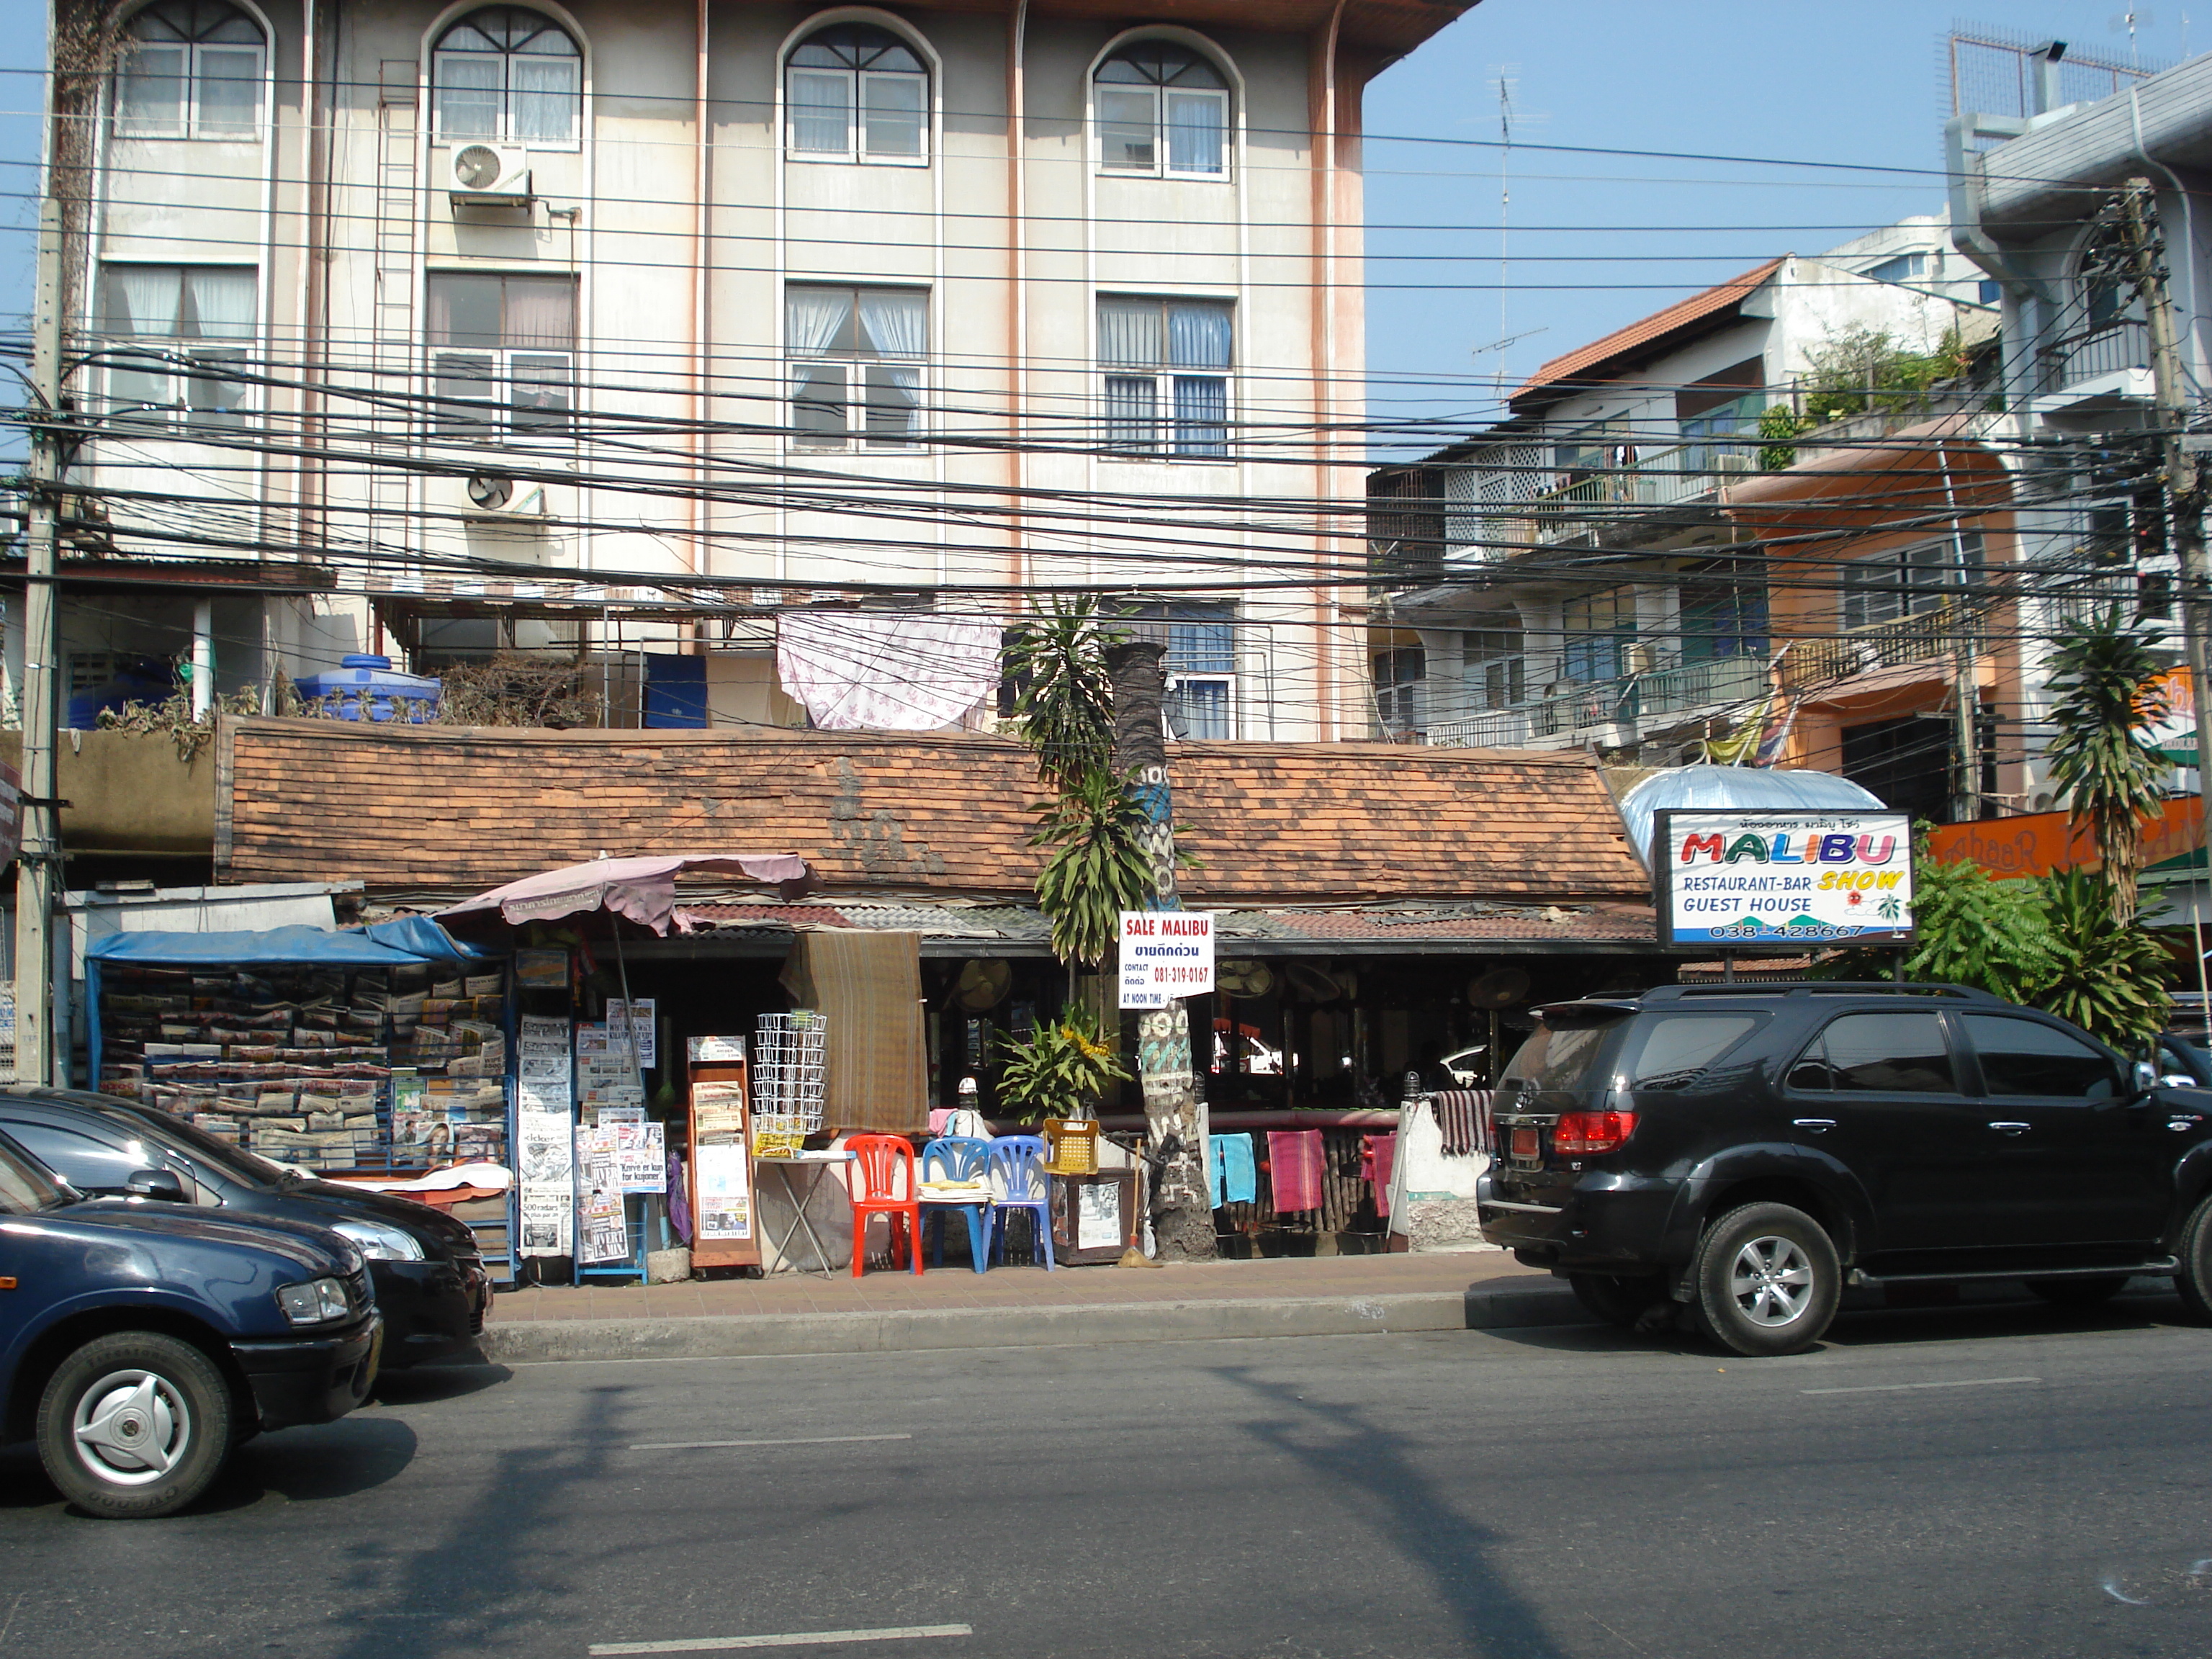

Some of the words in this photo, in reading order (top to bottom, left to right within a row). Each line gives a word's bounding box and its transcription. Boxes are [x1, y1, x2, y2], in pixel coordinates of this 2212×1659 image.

[1681, 833, 1896, 864] MALIBU
[2057, 818, 2205, 868] INIAN
[1683, 876, 1812, 891] RESTAURANT-BAR
[1817, 871, 1906, 891] SHOW
[1683, 898, 1743, 912] GUEST
[1750, 898, 1812, 912] HOUSE
[1126, 920, 1155, 936] SALE
[1162, 920, 1208, 936] MALIBU
[1154, 967, 1208, 983] 081-319-0167
[1123, 993, 1129, 1004] AT
[1131, 993, 1148, 1004] NOON
[1149, 993, 1161, 1004] TIME
